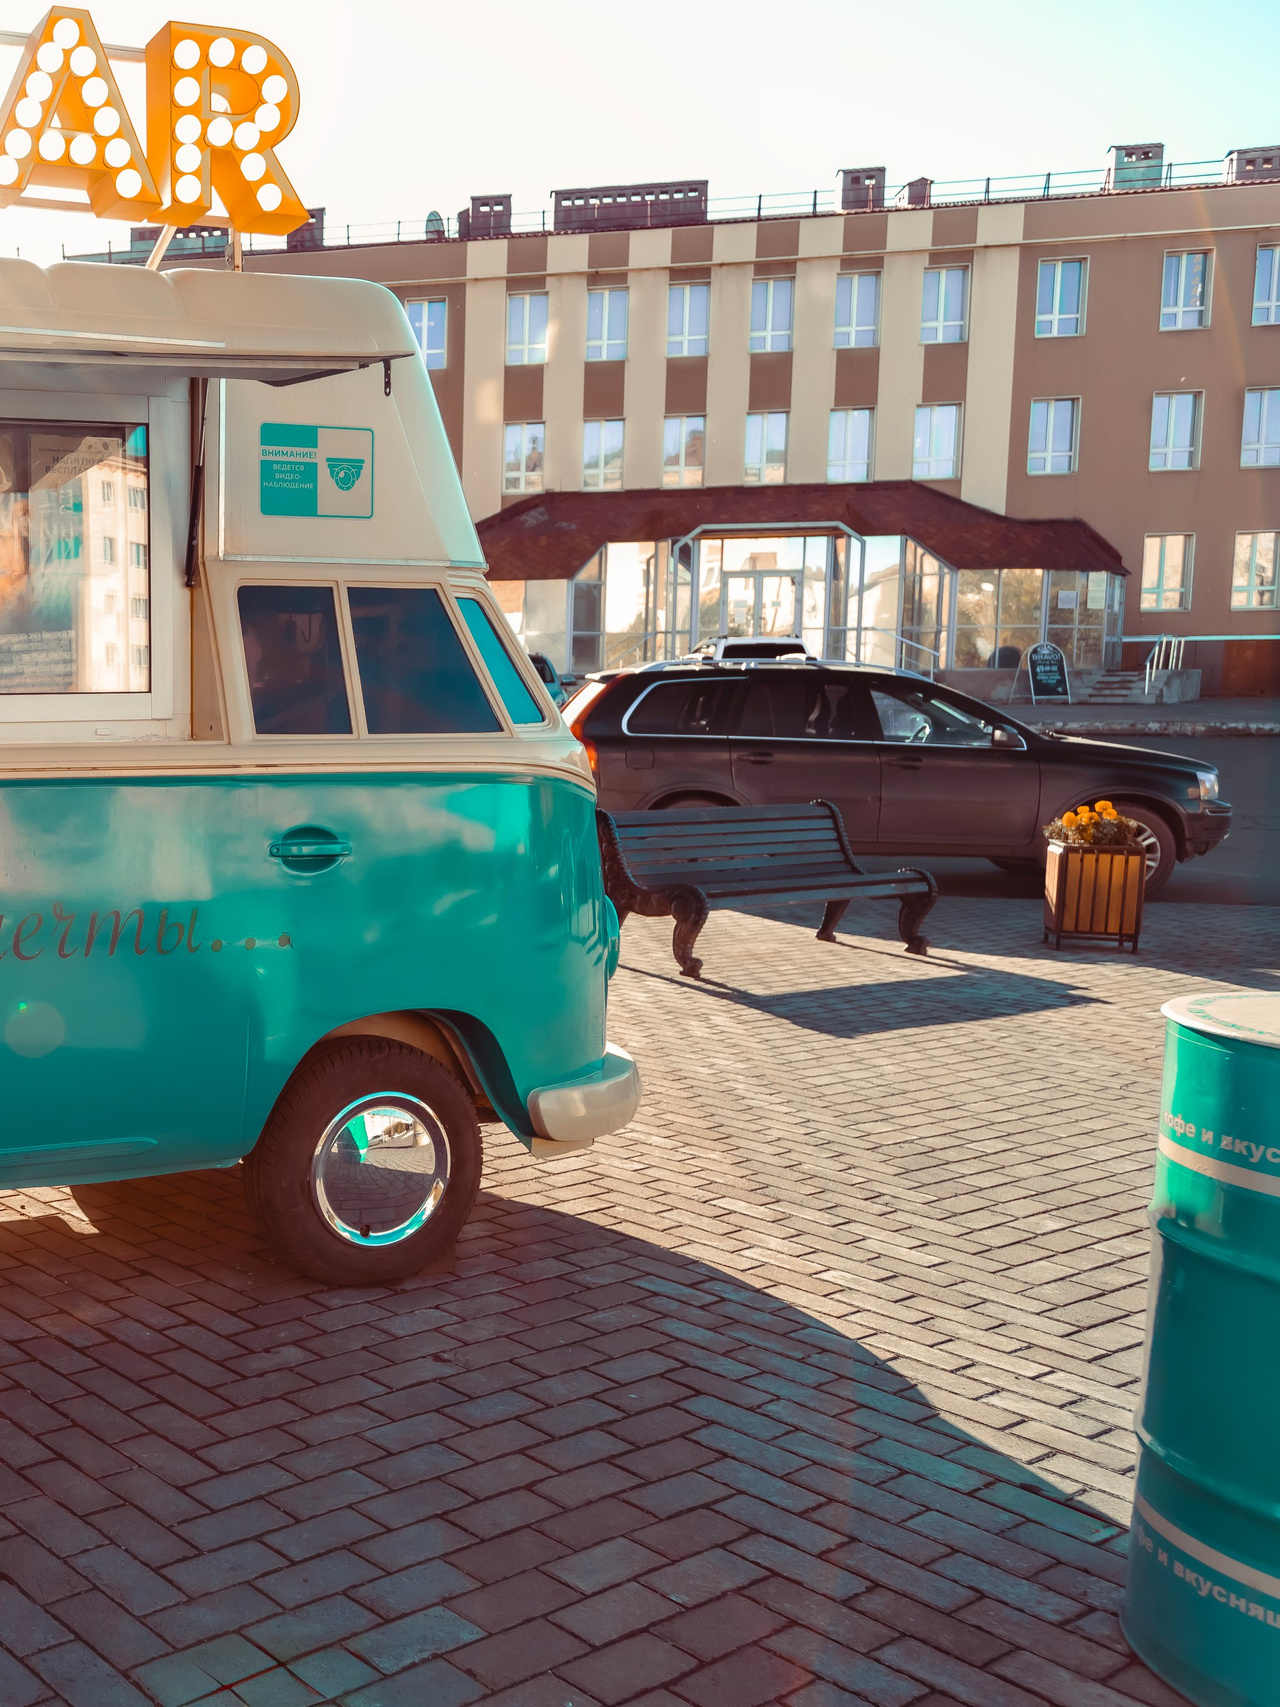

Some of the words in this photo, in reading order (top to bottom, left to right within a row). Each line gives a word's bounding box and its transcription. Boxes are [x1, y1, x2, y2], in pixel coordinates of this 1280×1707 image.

[262, 449, 316, 458] ВНИМАНИЕ!
[1200, 1127, 1214, 1145] и
[1220, 1134, 1280, 1164] вкус
[1157, 1548, 1168, 1566] и
